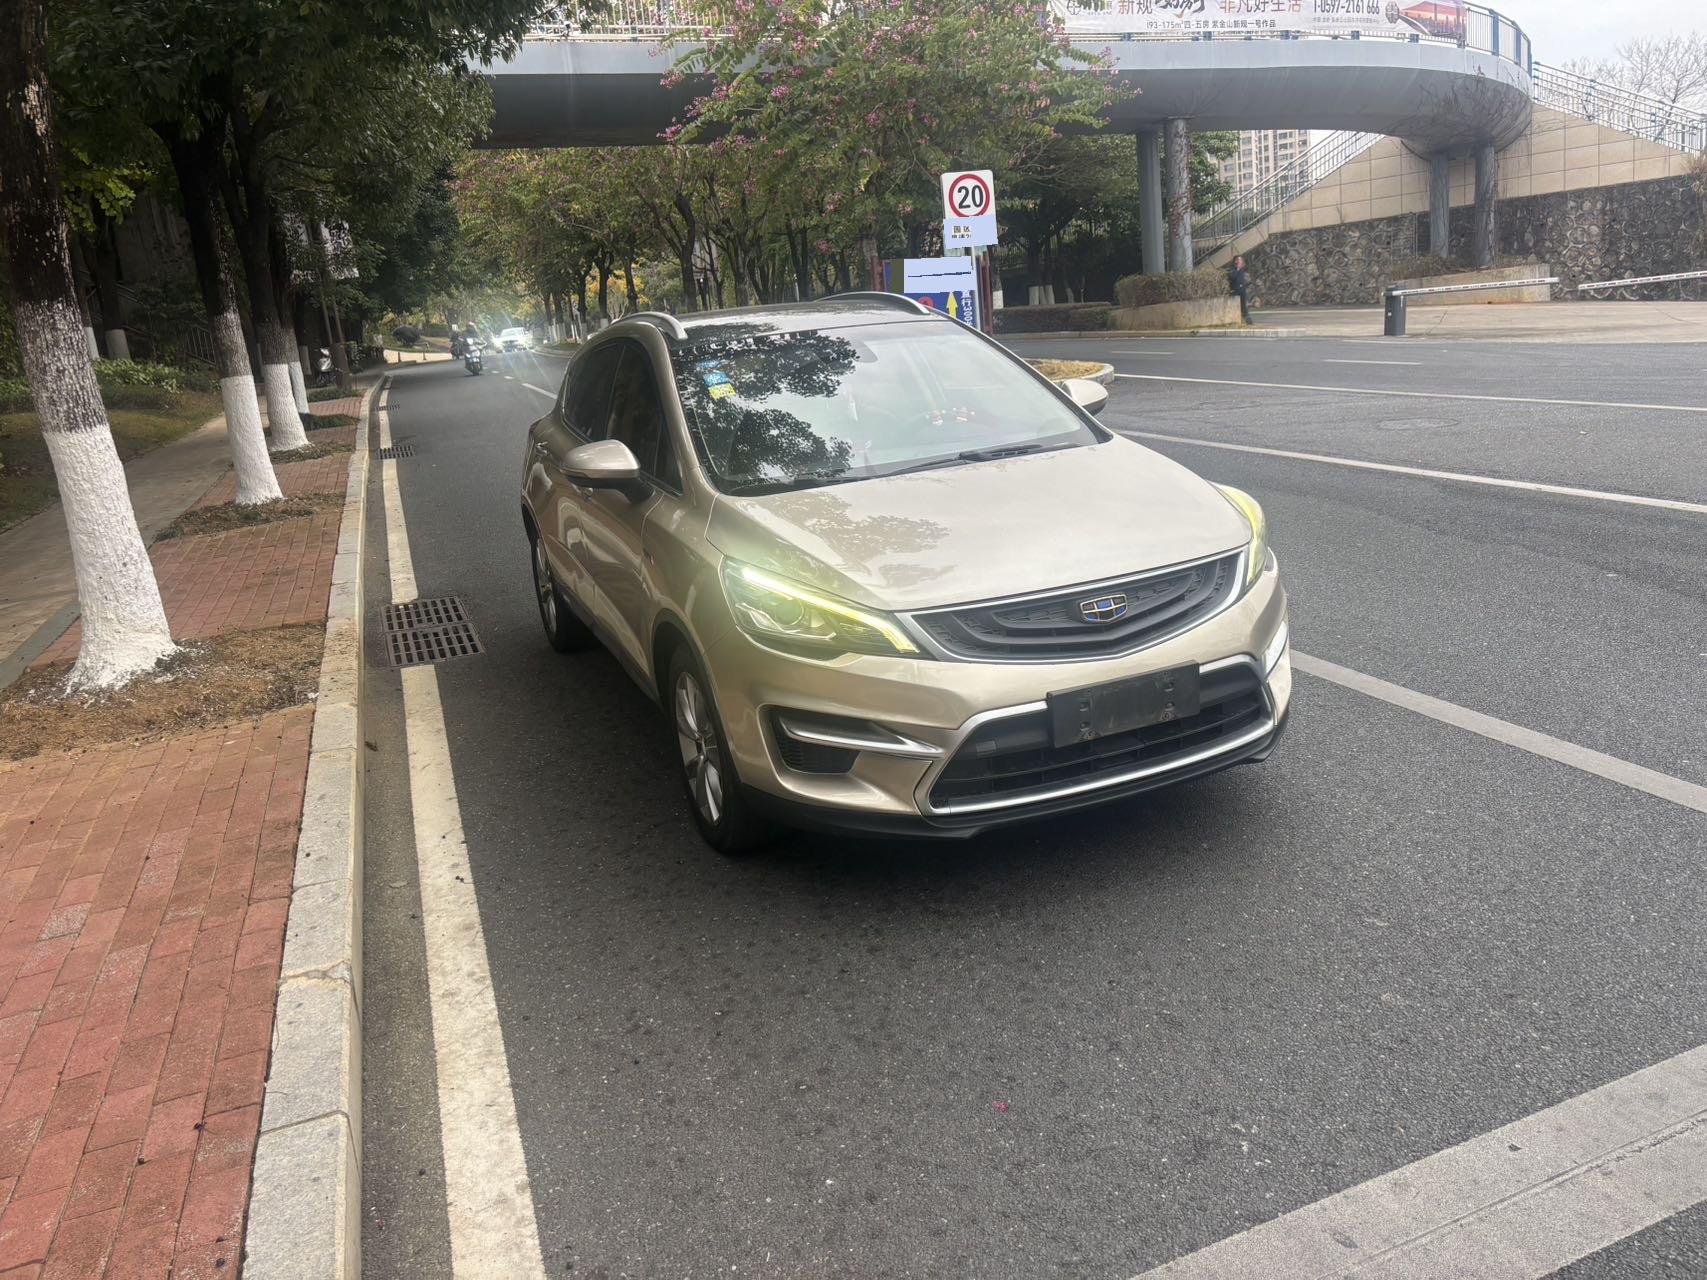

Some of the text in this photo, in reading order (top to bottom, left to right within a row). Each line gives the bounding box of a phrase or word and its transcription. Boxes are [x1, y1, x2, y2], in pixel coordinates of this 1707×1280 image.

[1219, 0, 1303, 13] 非凡好生活
[957, 184, 984, 209] 20
